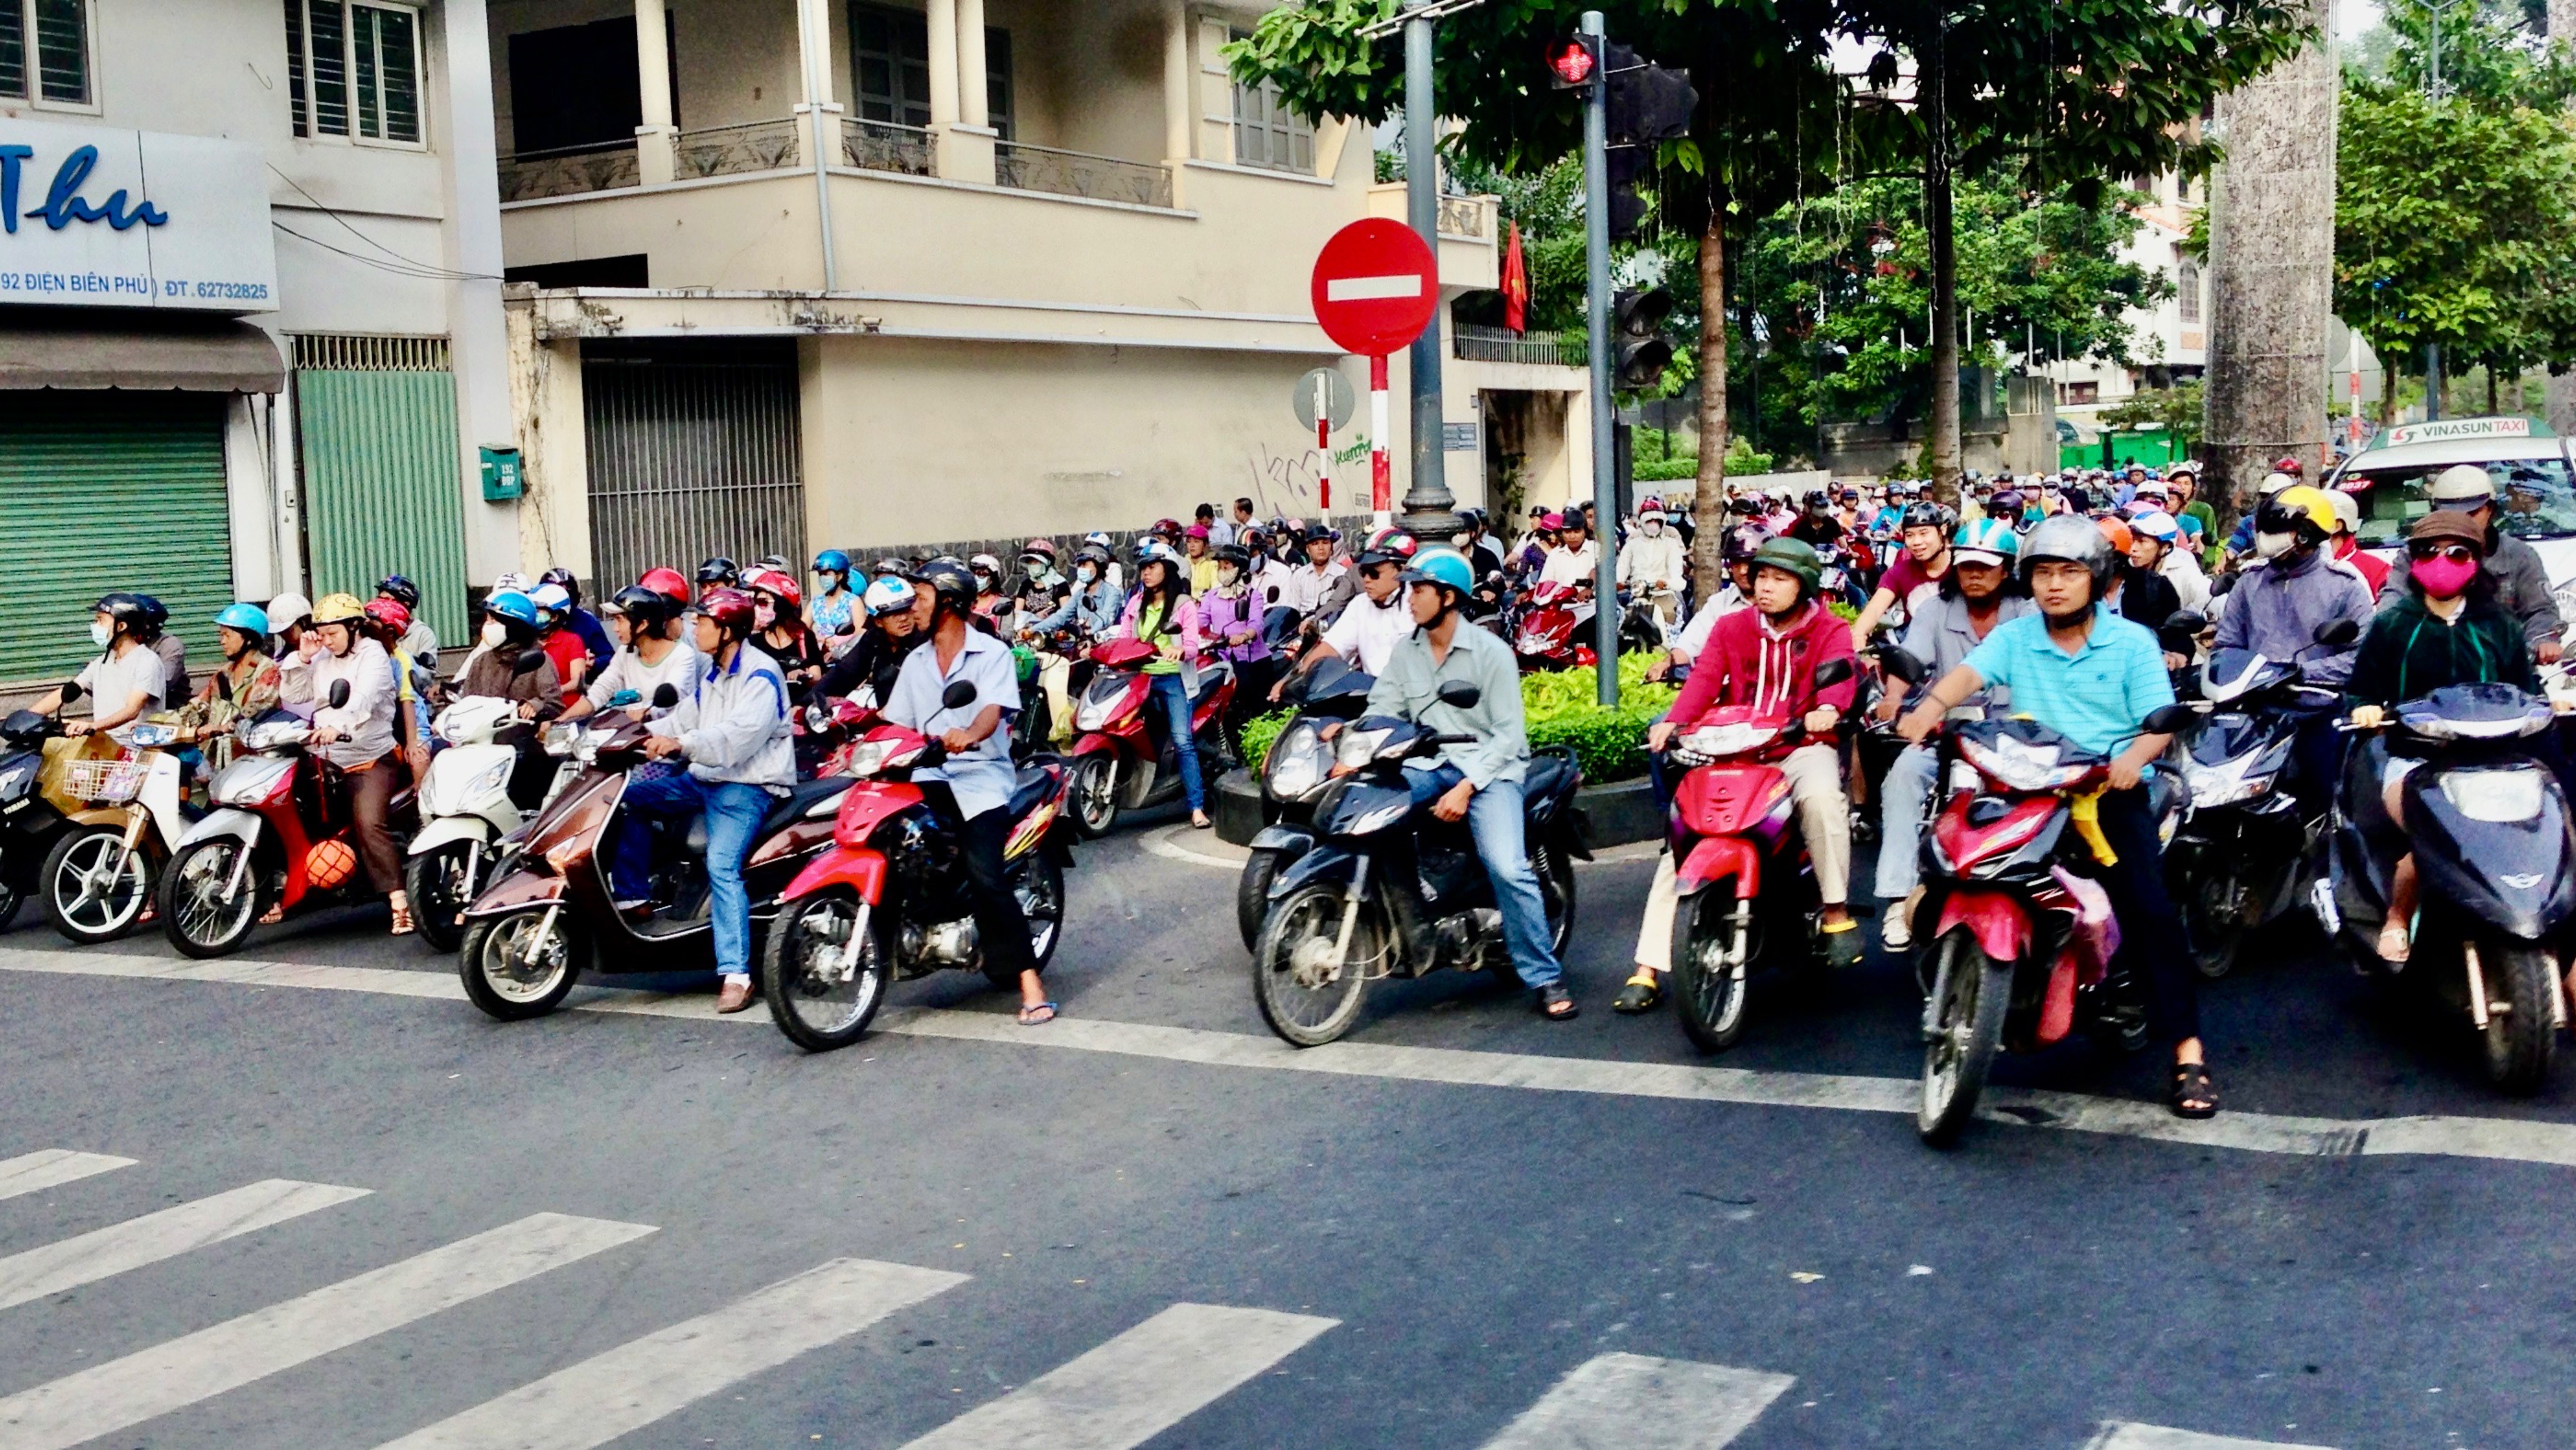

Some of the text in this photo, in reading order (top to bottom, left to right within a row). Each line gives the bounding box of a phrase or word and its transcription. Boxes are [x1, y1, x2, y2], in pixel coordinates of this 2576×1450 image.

[0, 144, 167, 233] Thu
[2, 273, 20, 290] 92
[25, 271, 65, 294] ĐIỆN
[70, 271, 109, 292] BIÊN
